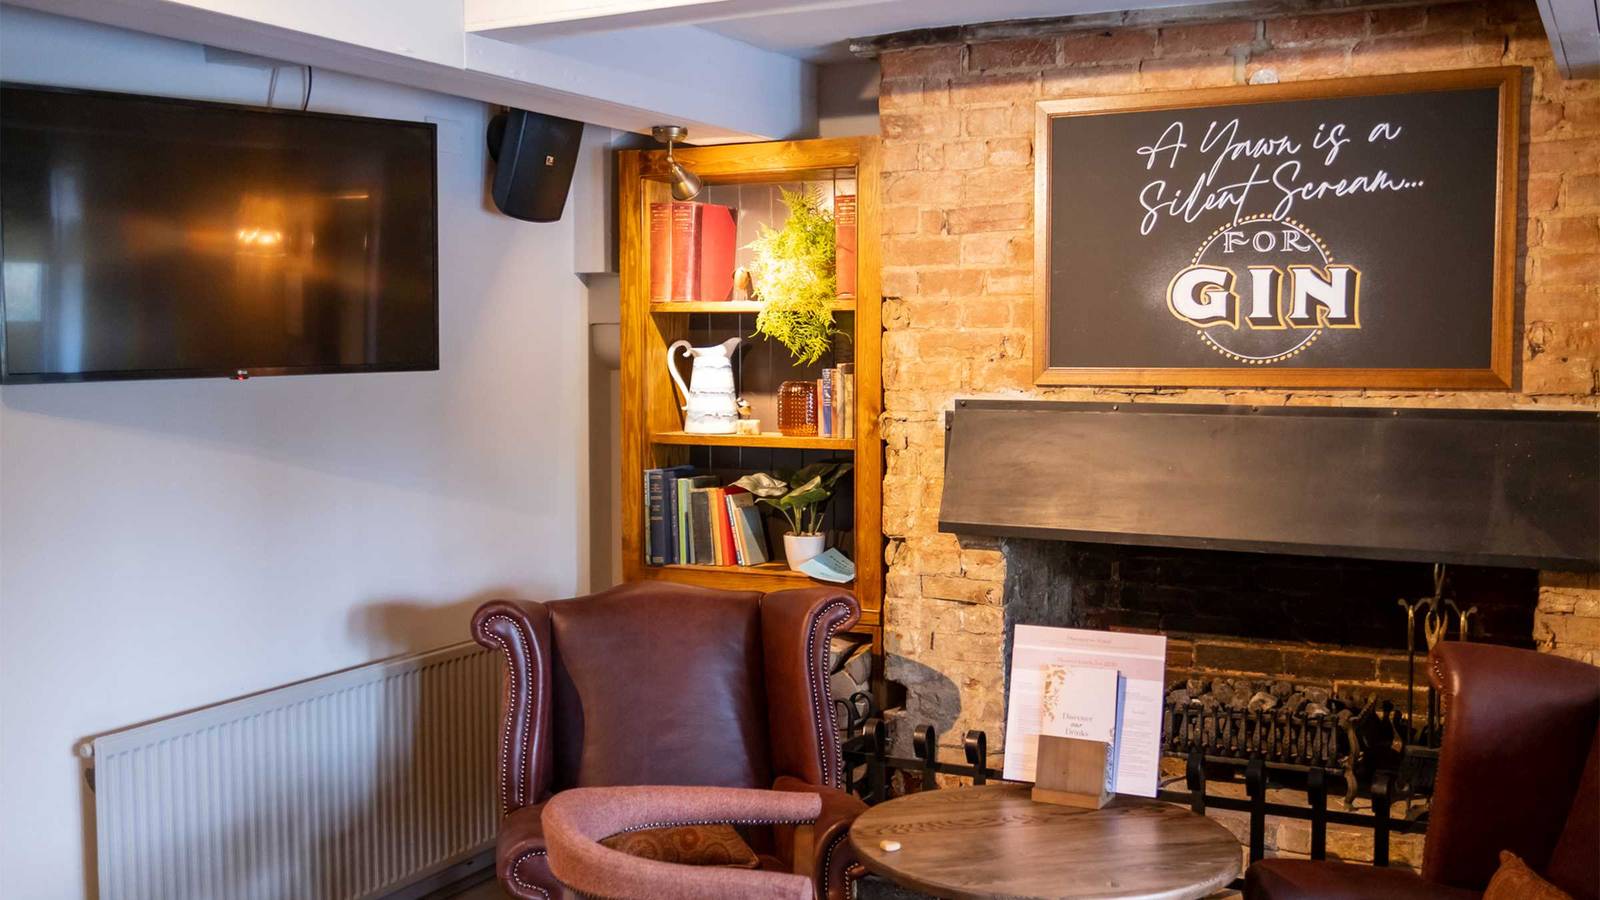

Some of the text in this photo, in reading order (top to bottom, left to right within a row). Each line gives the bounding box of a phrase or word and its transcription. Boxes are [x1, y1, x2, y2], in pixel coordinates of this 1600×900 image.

[1137, 118, 1402, 186] A Yawn is a
[1139, 160, 1424, 235] Silent Scream...
[1223, 230, 1311, 253] FOR
[1166, 264, 1361, 330] GIN
